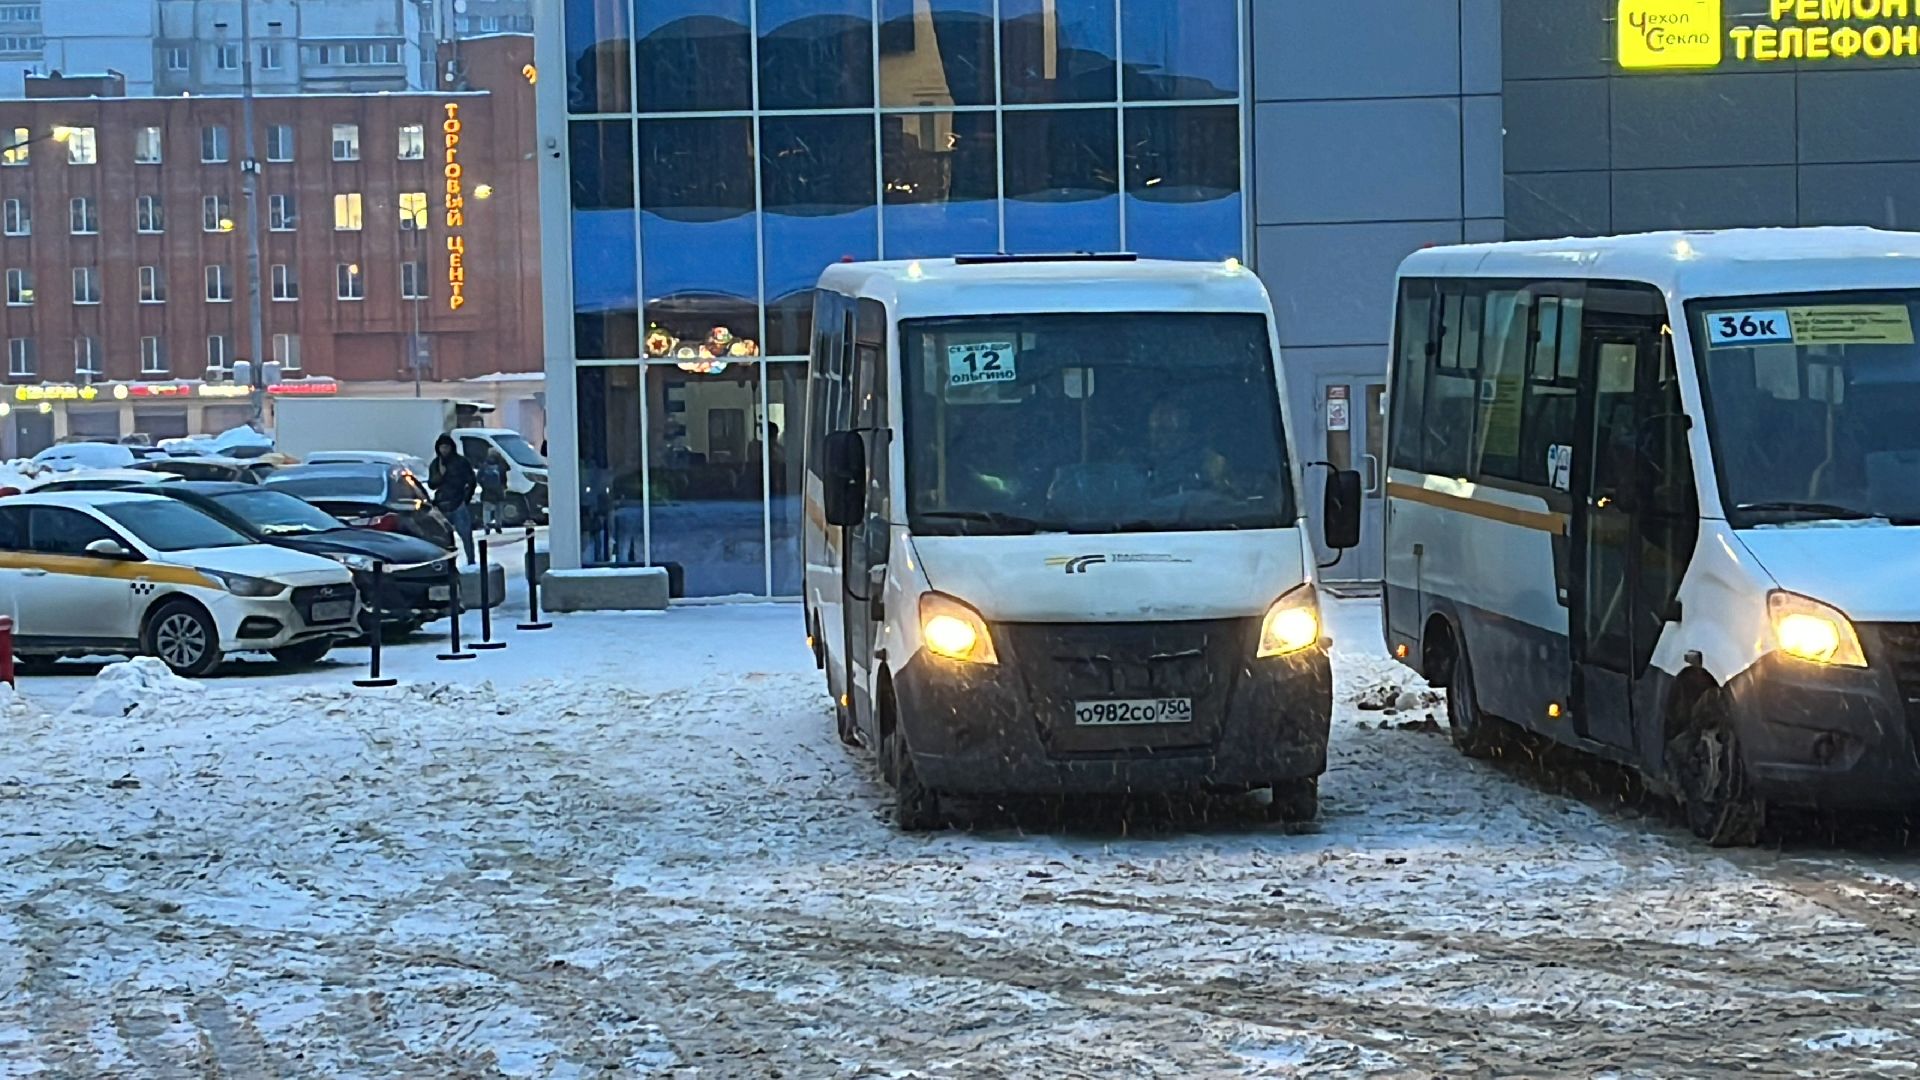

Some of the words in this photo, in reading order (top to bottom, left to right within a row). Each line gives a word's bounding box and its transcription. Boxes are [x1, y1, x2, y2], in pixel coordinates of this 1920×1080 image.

[1770, 0, 1920, 20] РЕМОН
[1629, 11, 1689, 36] Чехол
[1729, 25, 1920, 59] ТЕЛЕФОН
[443, 103, 464, 227] ТОРГОВЫЙ
[447, 236, 464, 310] ЦЕНТР
[962, 350, 1001, 373] 12
[952, 370, 1014, 382] ОЛЬГИНО
